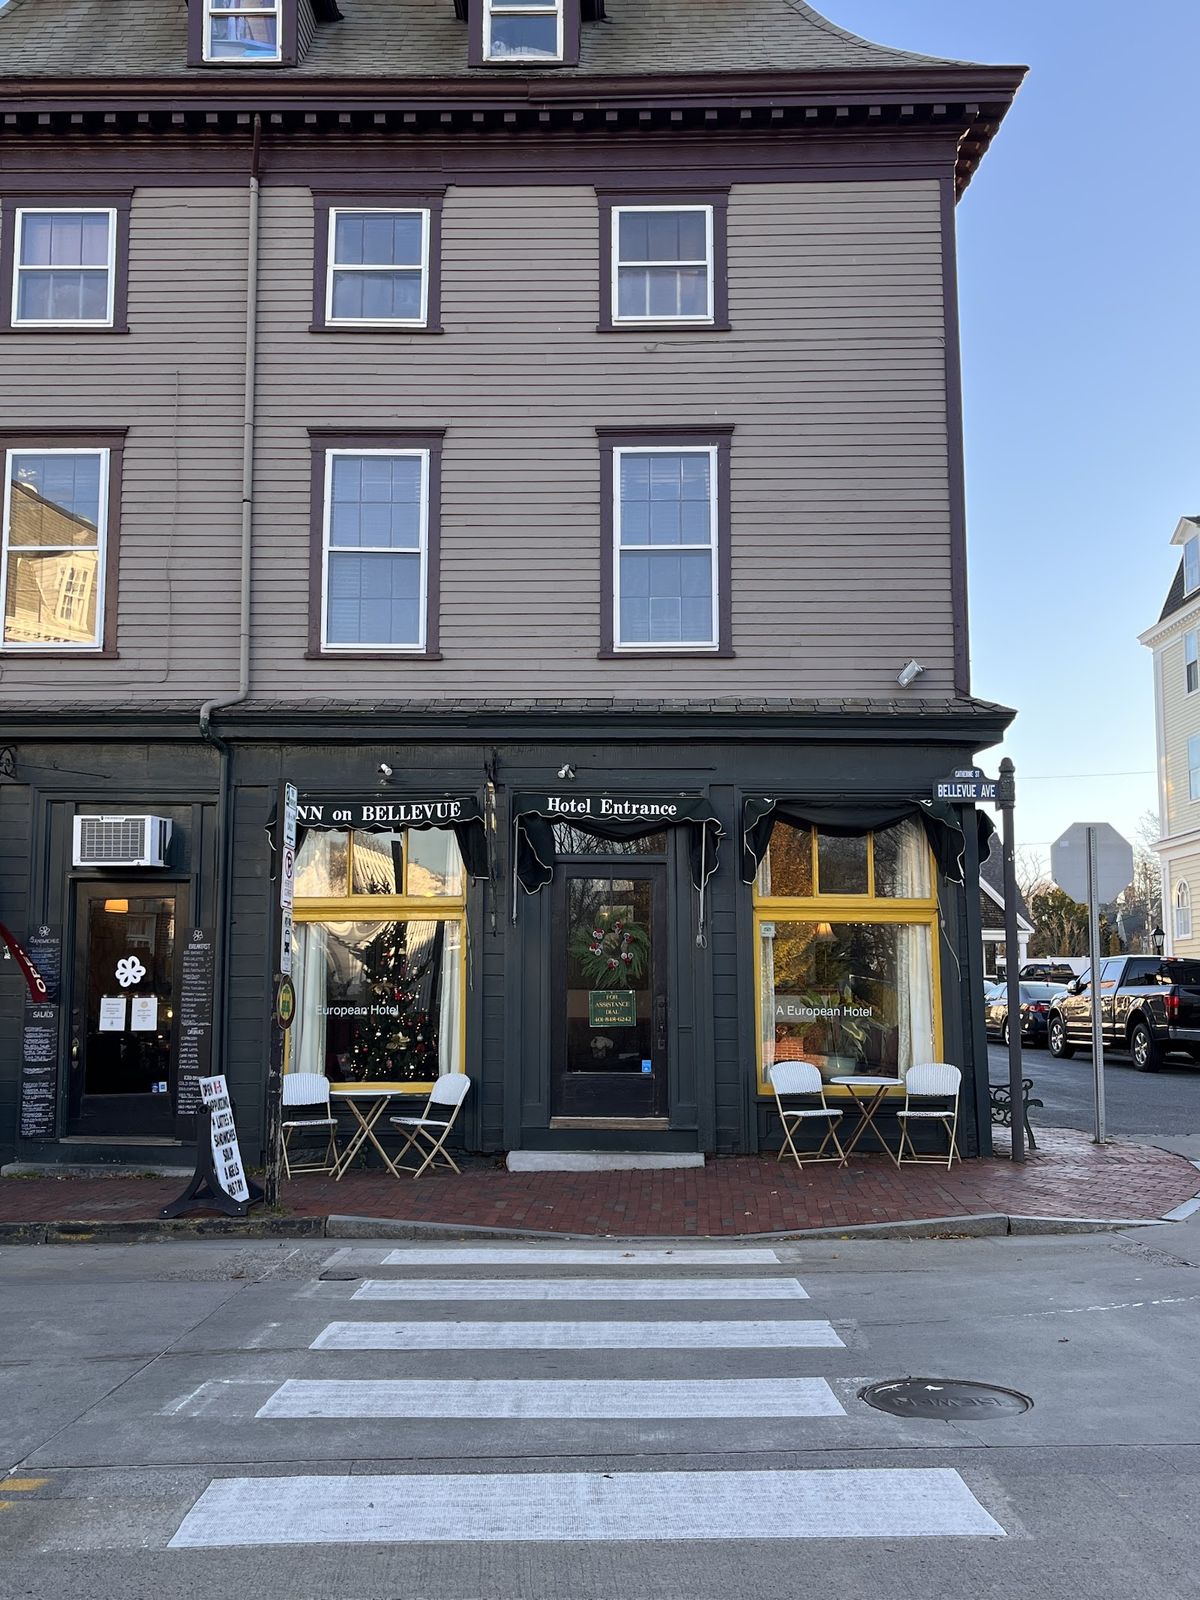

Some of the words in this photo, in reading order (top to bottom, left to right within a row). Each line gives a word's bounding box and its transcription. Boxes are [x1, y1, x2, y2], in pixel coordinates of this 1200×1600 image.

[954, 770, 974, 778] CATHERINE
[974, 770, 980, 778] ST
[937, 784, 977, 798] BELLEVUE
[980, 784, 996, 798] AVE
[296, 805, 325, 821] NN
[332, 808, 352, 821] on
[361, 801, 462, 821] BELLEVUE
[546, 797, 591, 814] Hotel
[600, 798, 677, 815] Entrance
[315, 1005, 367, 1018] European
[370, 1004, 399, 1016] Hotel
[776, 1005, 785, 1015] A
[787, 1005, 840, 1018] European
[843, 1006, 873, 1017] Hotel
